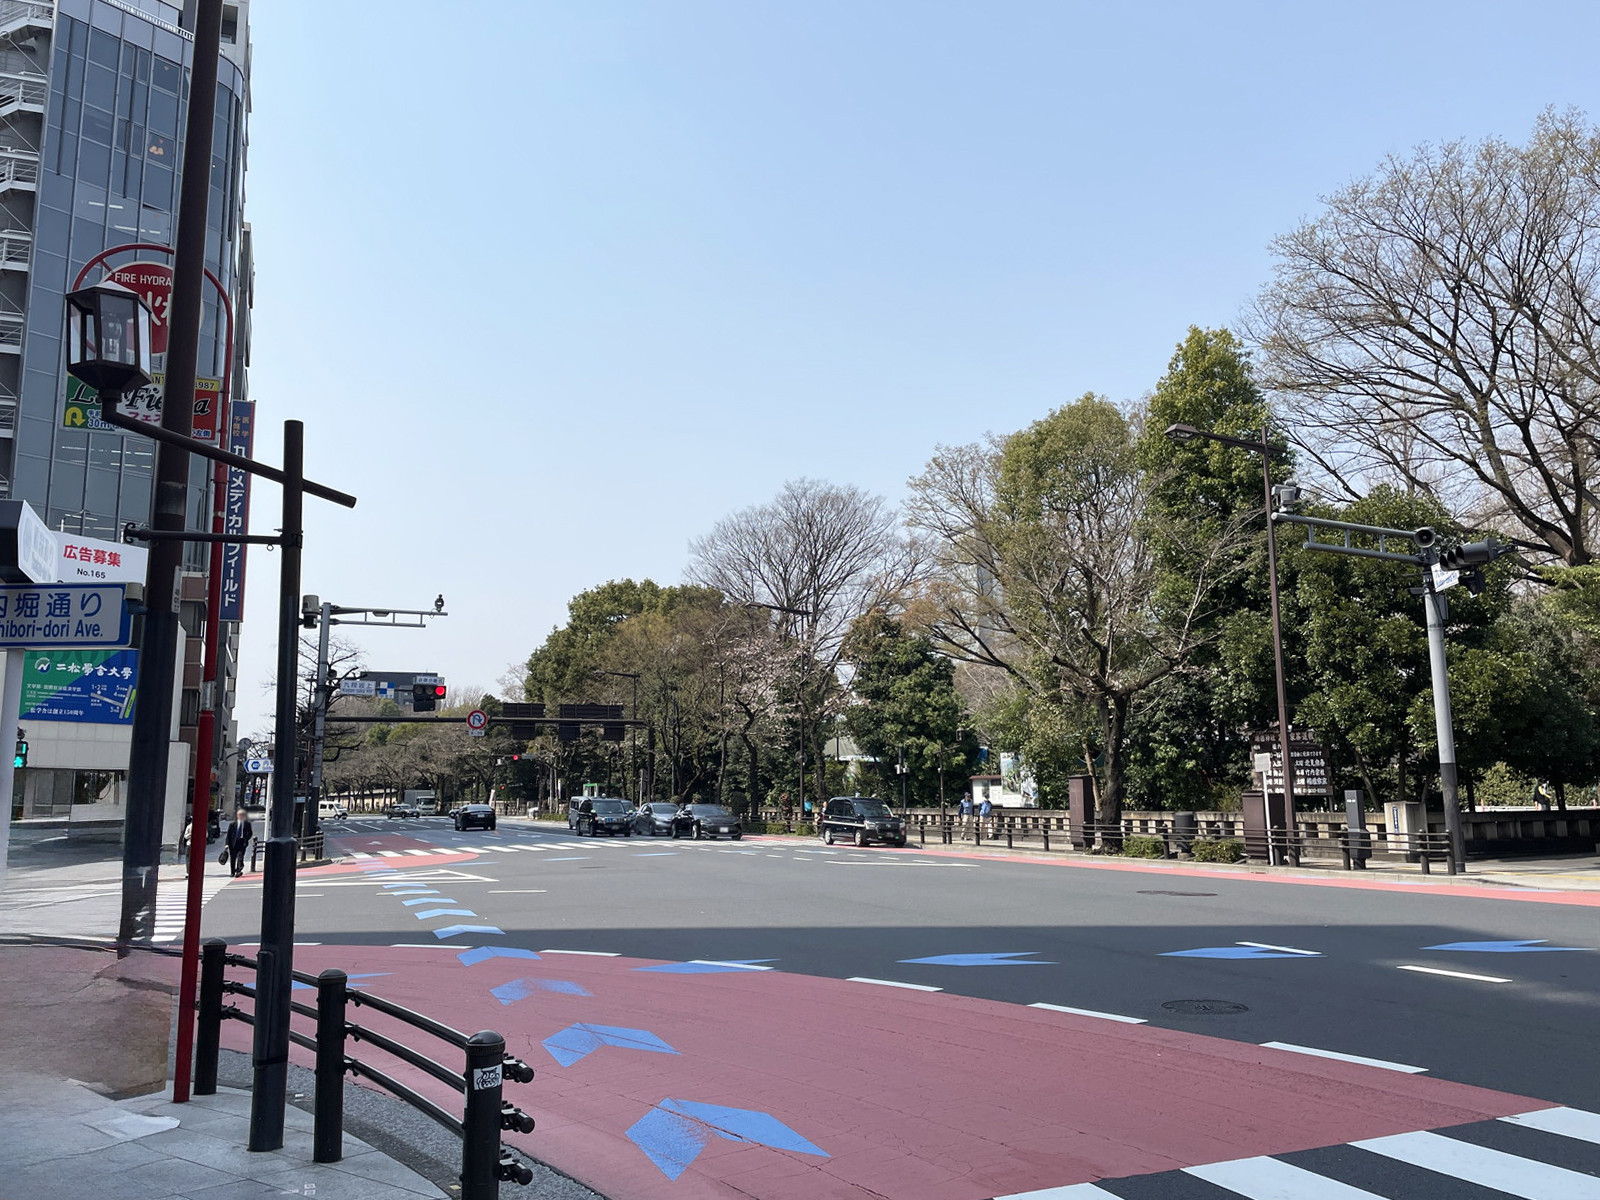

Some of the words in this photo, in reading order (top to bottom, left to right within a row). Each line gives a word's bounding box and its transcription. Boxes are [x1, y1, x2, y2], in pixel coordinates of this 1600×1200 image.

[114, 272, 137, 284] FIRE
[224, 444, 247, 608] 九メディカフィールド
[63, 543, 122, 568] 広告募集
[76, 567, 106, 579] No.165
[74, 619, 104, 637] Ave.
